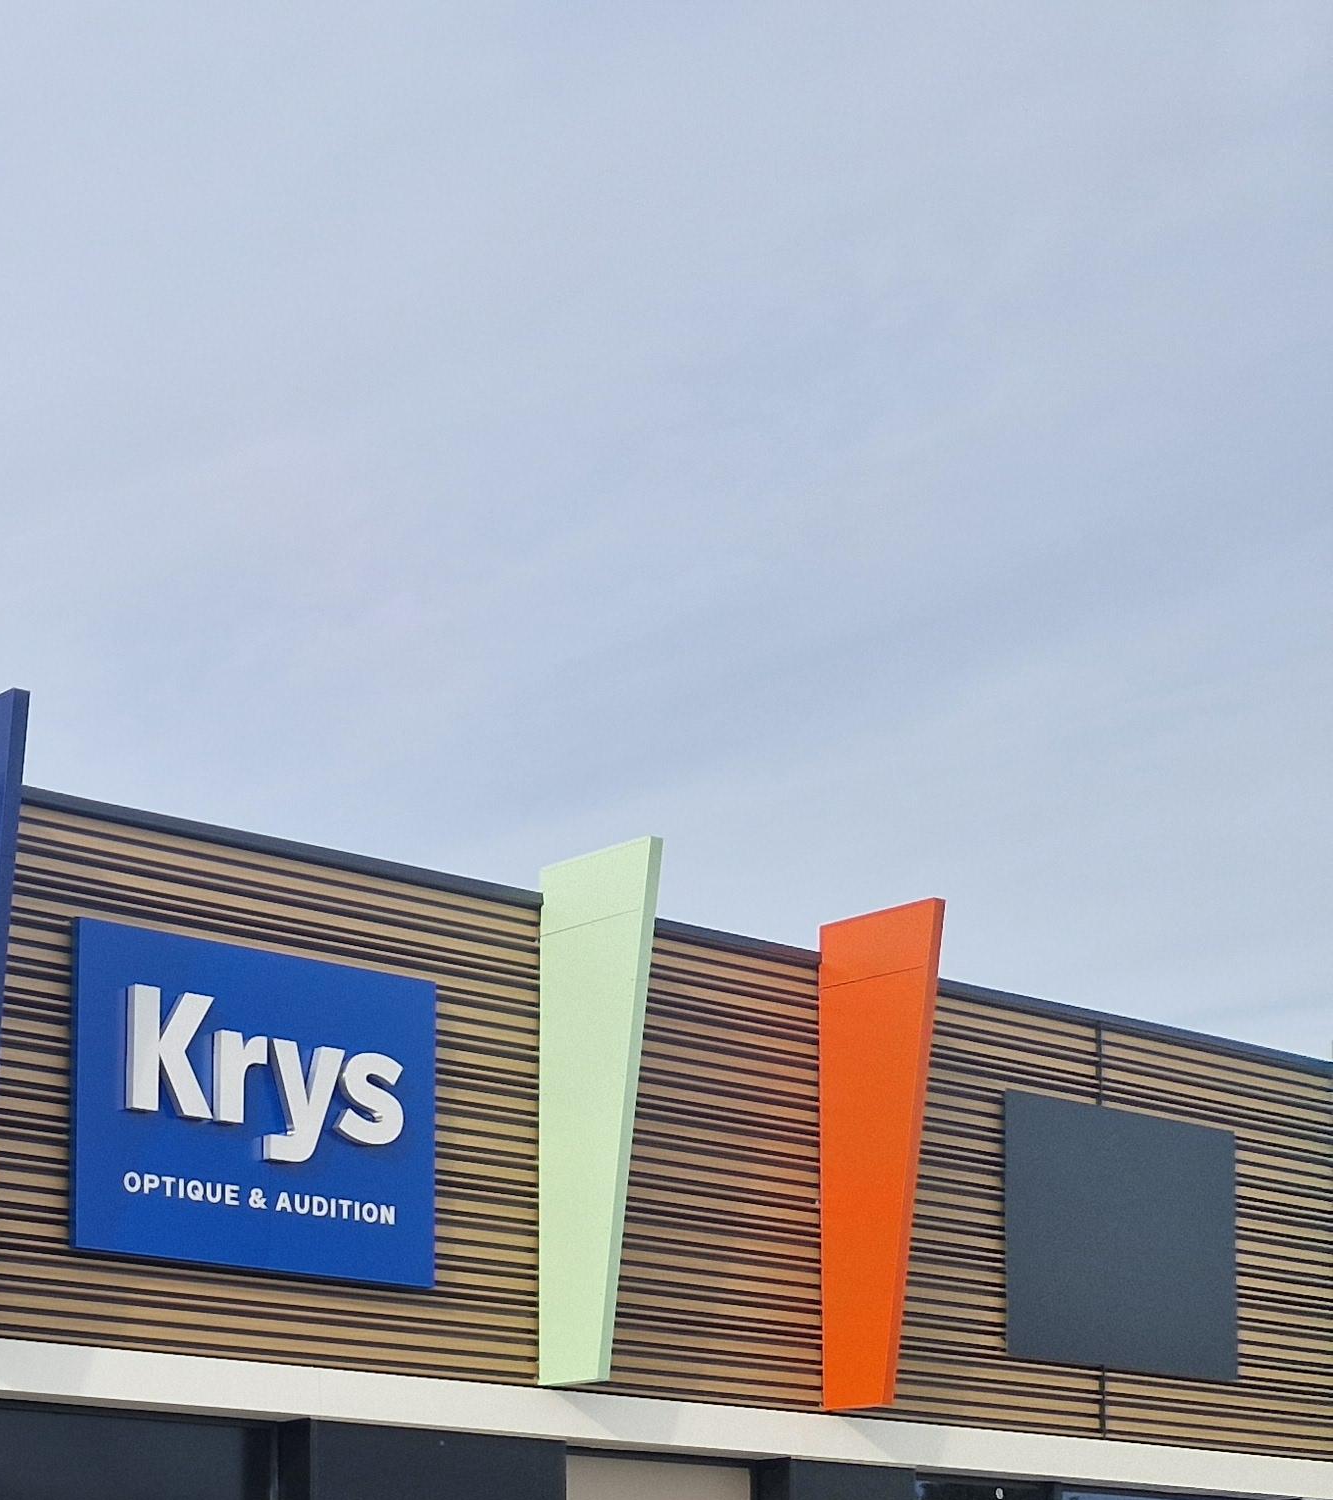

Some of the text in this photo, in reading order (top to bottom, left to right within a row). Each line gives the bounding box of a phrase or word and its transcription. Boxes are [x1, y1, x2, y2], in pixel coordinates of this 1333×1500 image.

[126, 982, 406, 1163] Krys
[123, 1171, 397, 1226] OPTIQUE & AUDITION
